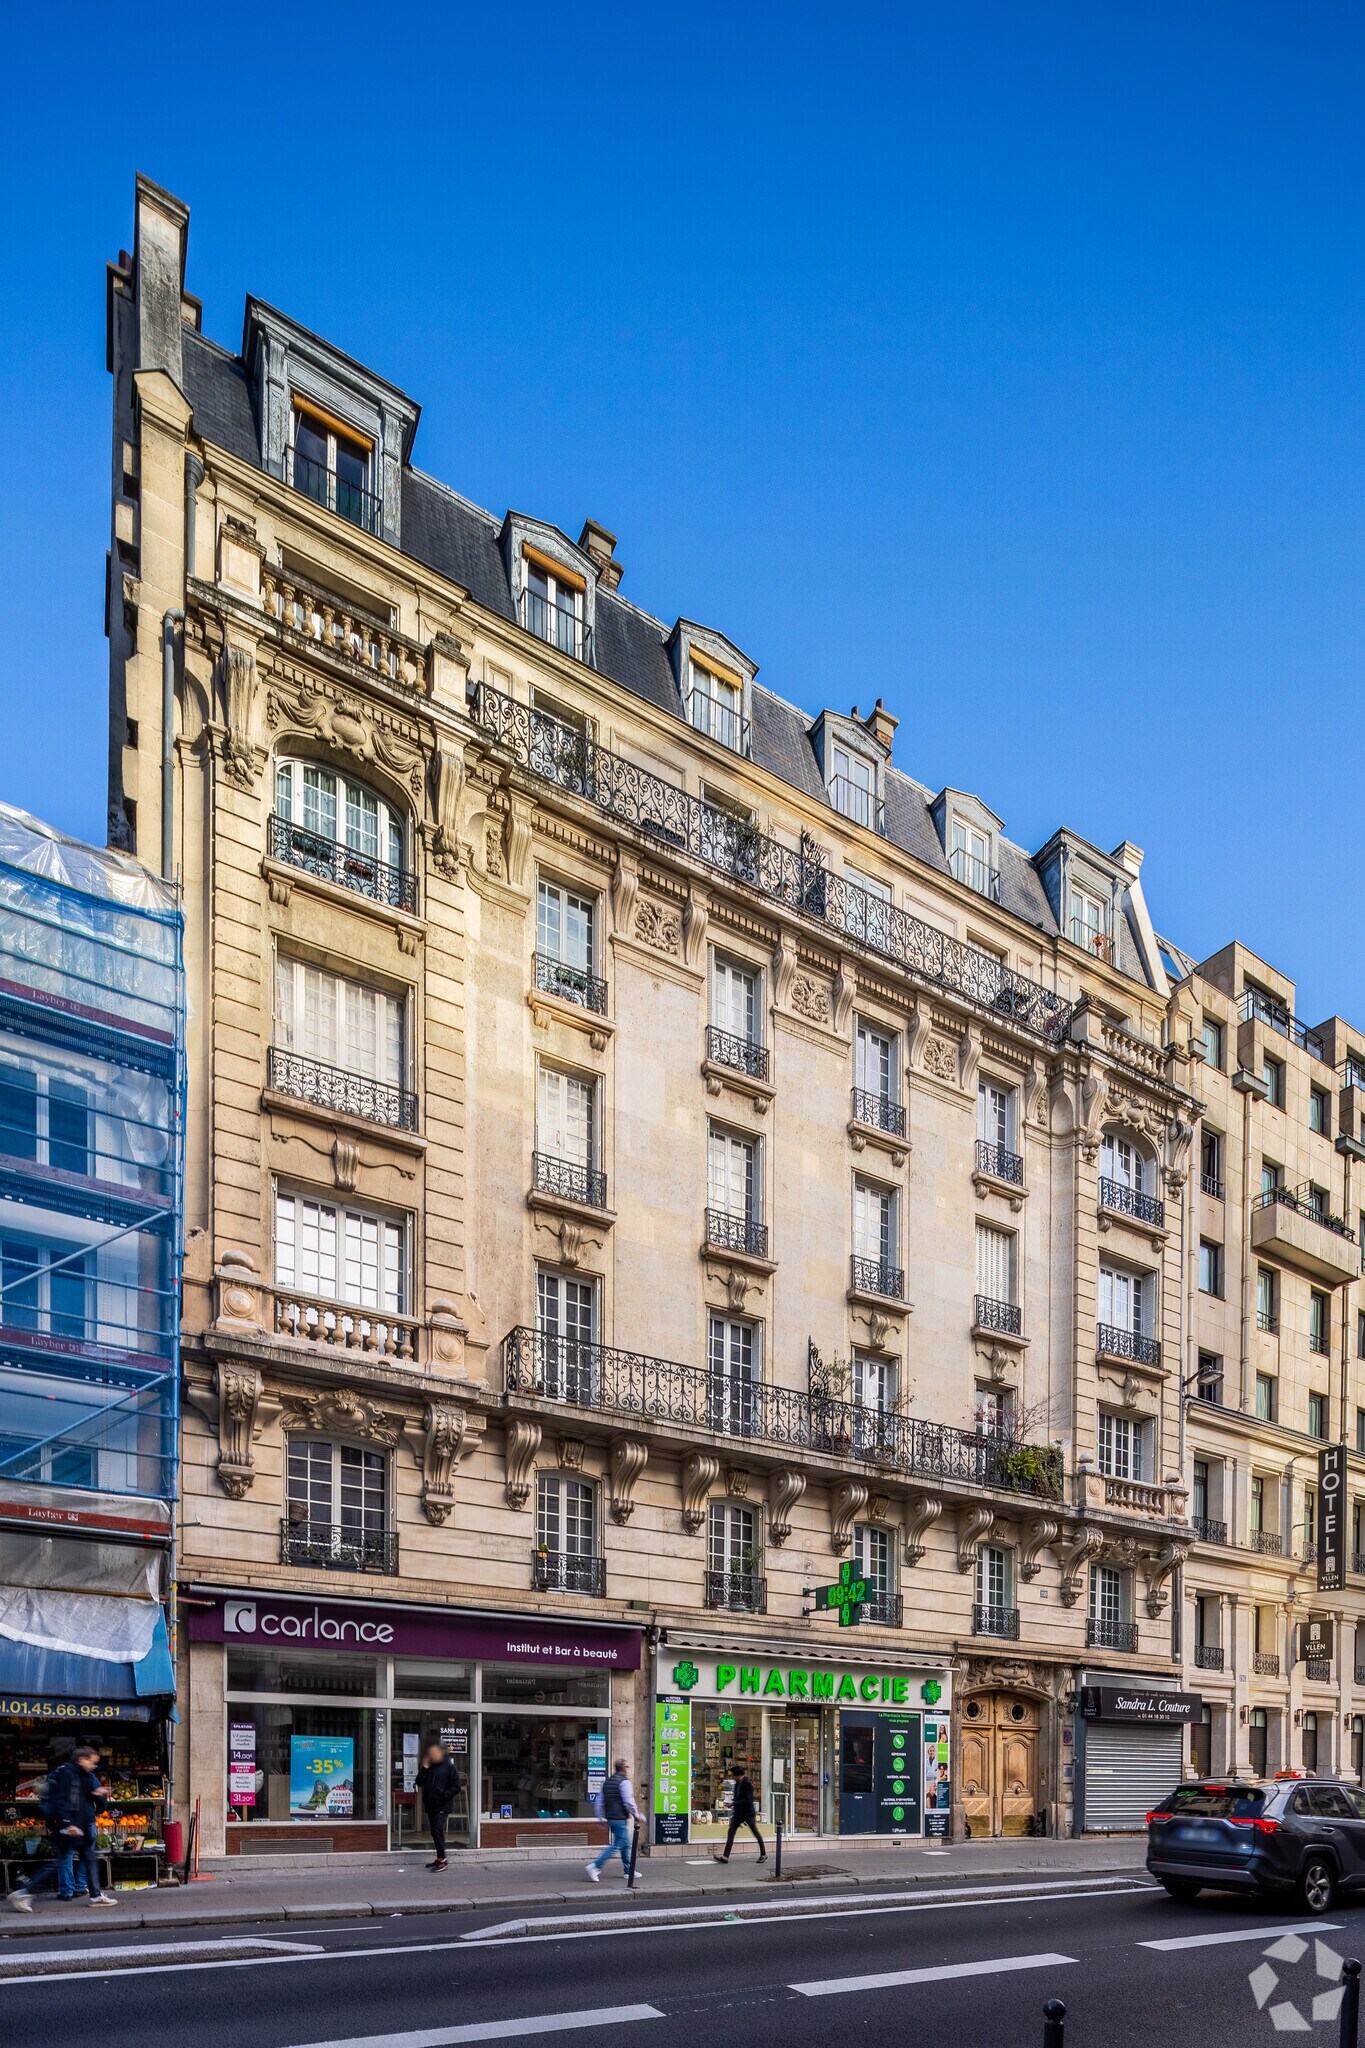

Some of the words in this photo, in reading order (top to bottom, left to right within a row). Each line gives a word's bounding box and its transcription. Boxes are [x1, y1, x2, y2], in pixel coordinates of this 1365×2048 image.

[32, 990, 66, 1007] Layher
[31, 1336, 65, 1350] Layher
[1322, 1451, 1339, 1553] HOTEL
[28, 1508, 63, 1520] Layher
[828, 1581, 865, 1606] 09:42
[261, 1607, 394, 1643] carlance
[507, 1642, 540, 1653] Institut
[542, 1645, 552, 1654] et
[555, 1646, 571, 1655] Bar
[574, 1647, 580, 1656] à
[583, 1648, 618, 1659] beauté
[716, 1664, 909, 1702] PHARMACIE
[790, 1695, 843, 1704] VOLONTAIRES
[1115, 1697, 1146, 1710] Sandra
[1147, 1700, 1155, 1711] L.
[1159, 1700, 1190, 1713] Couture
[306, 1759, 344, 1774] -35%
[376, 1713, 384, 1816] www.carlance.fr
